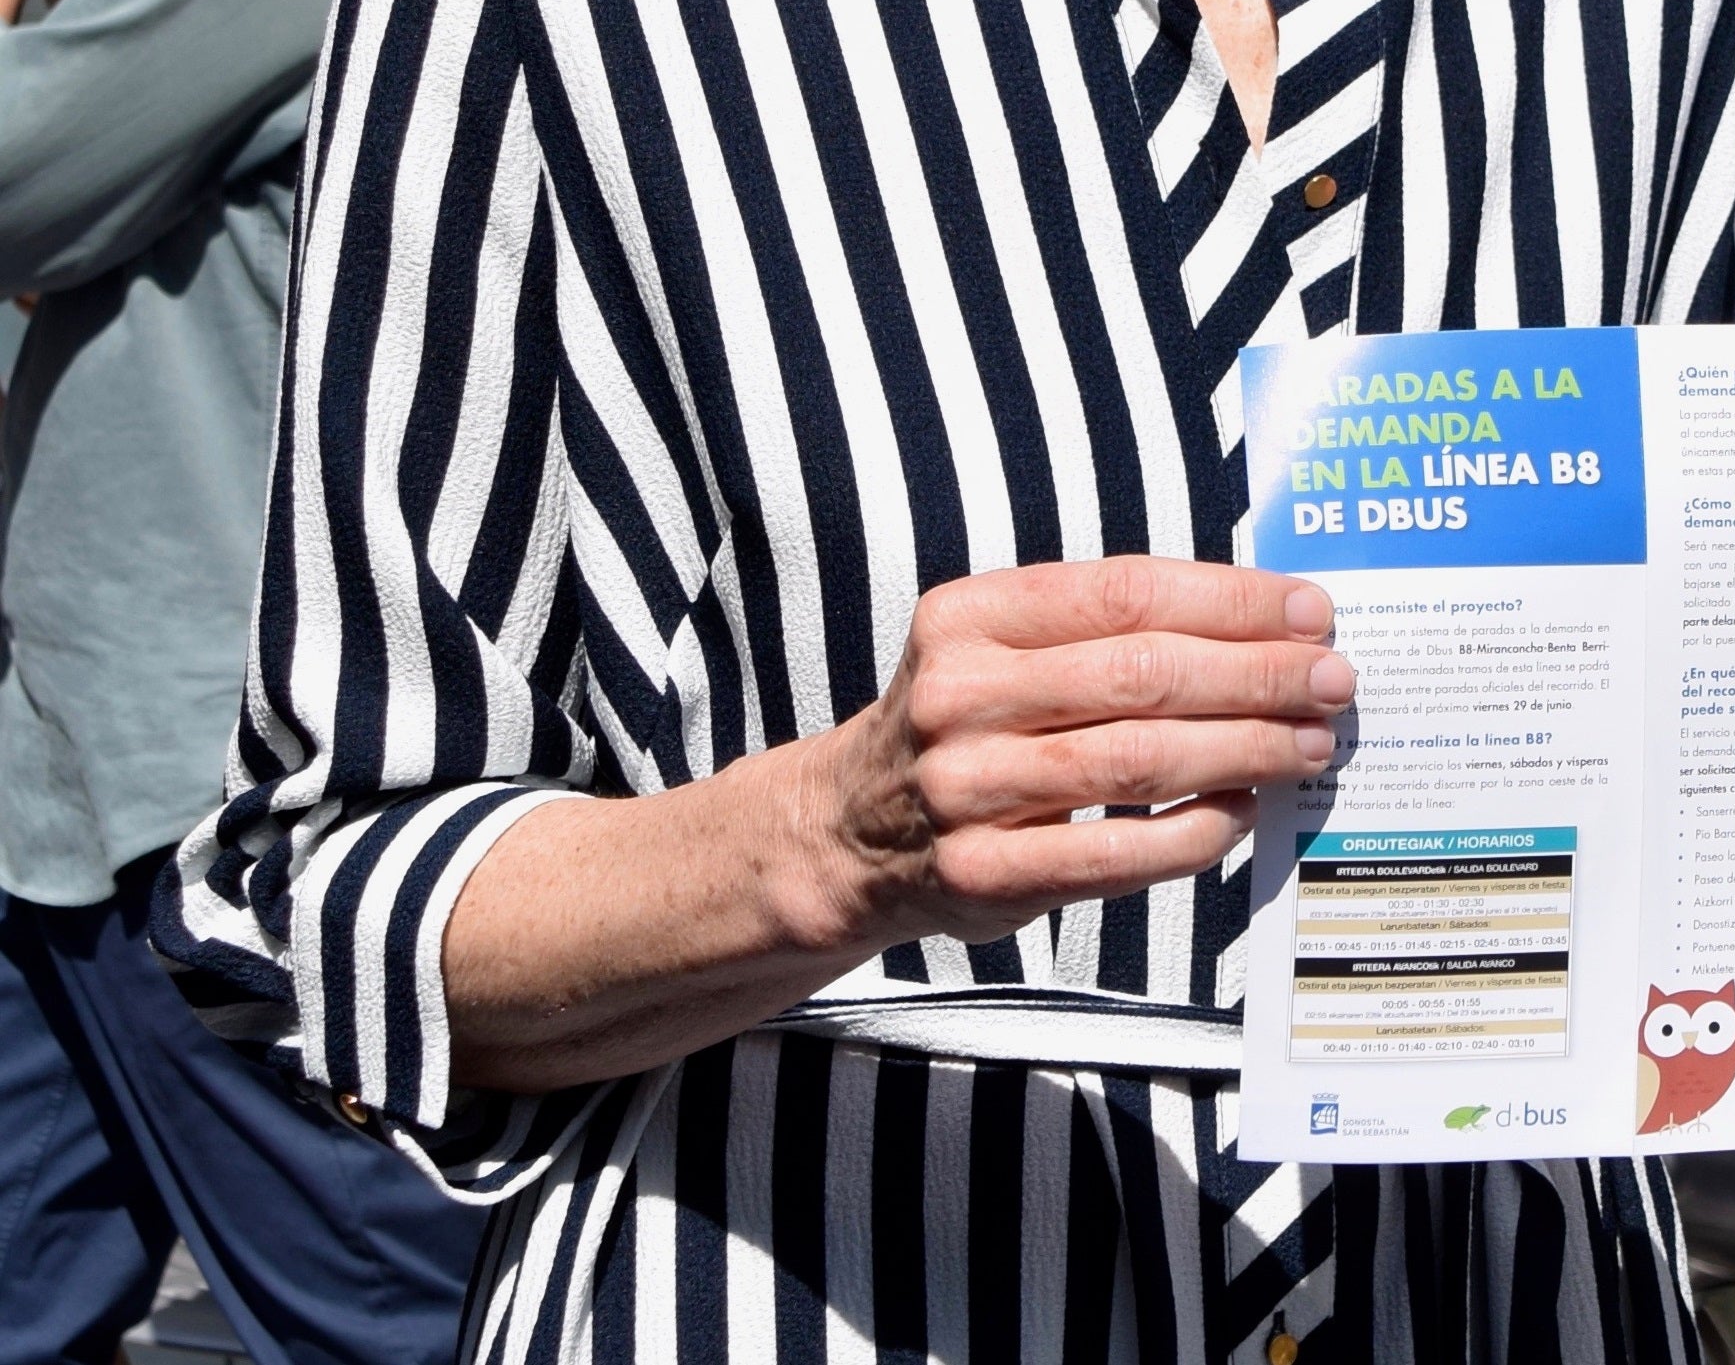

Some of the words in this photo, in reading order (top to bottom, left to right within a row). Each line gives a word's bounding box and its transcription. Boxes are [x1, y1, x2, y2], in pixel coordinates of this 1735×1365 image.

[1678, 366, 1729, 381] ¿Quién
[1314, 369, 1478, 409] ARADAS
[1491, 369, 1522, 400] A
[1533, 367, 1582, 400] LA
[1289, 411, 1501, 452] DEMANDA
[1290, 458, 1346, 492] EN
[1360, 456, 1411, 489] LA
[1422, 446, 1539, 487] LÍNEA
[1550, 450, 1601, 485] B8
[1684, 497, 1731, 513] ¿Cómo
[1293, 501, 1344, 535] DE
[1358, 496, 1467, 532] DBUS
[1334, 603, 1363, 618] qué
[1369, 601, 1427, 614] consiste
[1433, 599, 1445, 613] el
[1451, 599, 1522, 616] proyecto?
[1682, 667, 1705, 682] ¿En
[1710, 666, 1735, 681] qué
[1682, 684, 1702, 697] del
[1681, 702, 1724, 719] puede
[1346, 735, 1405, 752] servicio
[1410, 735, 1460, 748] realiza
[1466, 734, 1479, 746] la
[1485, 733, 1520, 745] línea
[1526, 732, 1552, 744] B8?
[1342, 837, 1445, 851] ORDUTEGIAK
[1457, 834, 1534, 849] HORARIOS
[1695, 852, 1724, 862] Paseo
[1694, 874, 1723, 885] Paseo
[1693, 895, 1733, 907] Aizkorri
[1342, 1128, 1360, 1136] SAN
[1363, 1127, 1409, 1136] SEBASTIÁN
